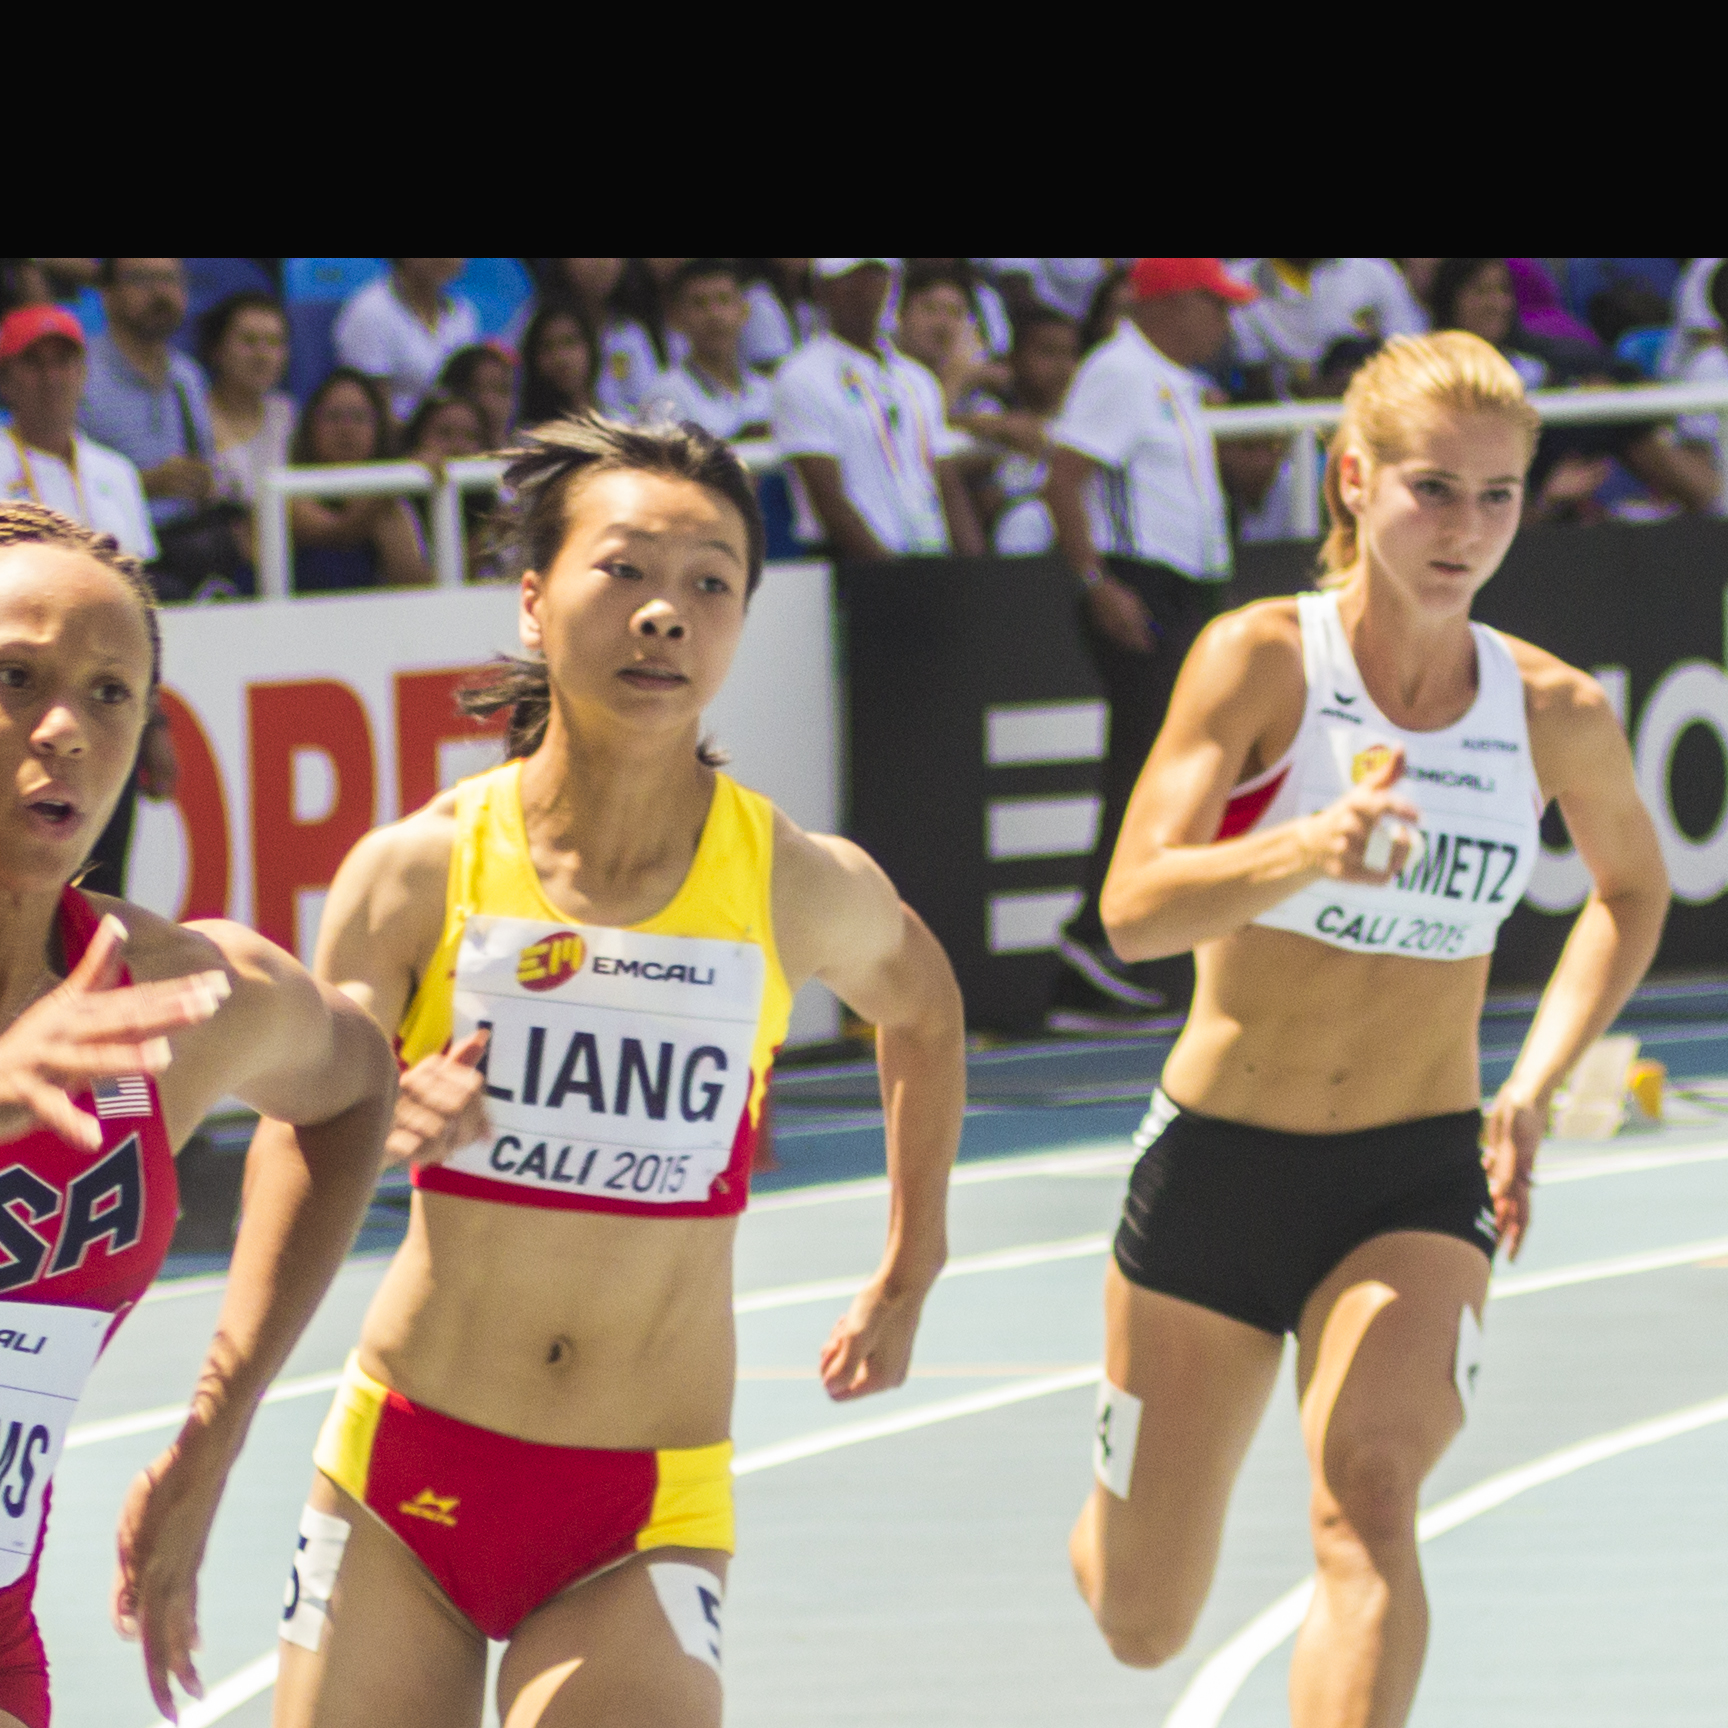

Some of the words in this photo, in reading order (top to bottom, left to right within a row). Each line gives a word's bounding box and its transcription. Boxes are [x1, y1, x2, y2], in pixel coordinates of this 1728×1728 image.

[1315, 904, 1399, 946] CALI
[592, 956, 715, 986] EMCALI
[476, 1019, 729, 1123] LIANG
[490, 1134, 600, 1187] CALI
[603, 1150, 694, 1195] 2015
